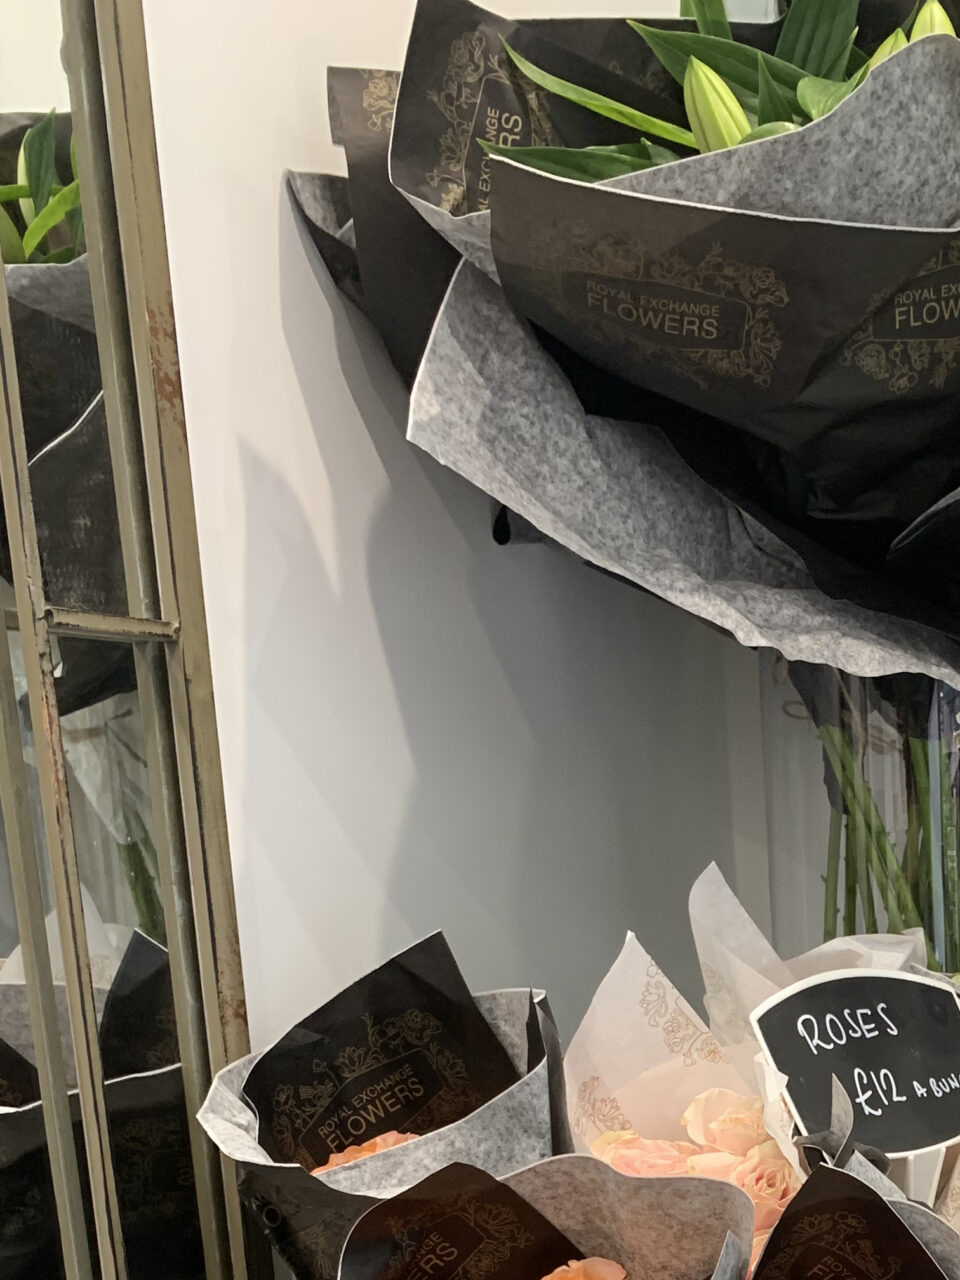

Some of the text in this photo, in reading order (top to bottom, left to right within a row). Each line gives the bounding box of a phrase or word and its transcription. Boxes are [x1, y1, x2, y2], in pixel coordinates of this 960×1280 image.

[586, 280, 721, 318] ROYAL EXCHANGE
[587, 292, 718, 339] FLOWERS
[894, 287, 937, 305] ROYAL
[797, 1002, 898, 1055] ROSES
[318, 1063, 415, 1139] ROYAL EXCHANGE
[326, 1077, 424, 1153] FLOWERS
[854, 1067, 907, 1116] £12
[913, 1080, 928, 1098] A
